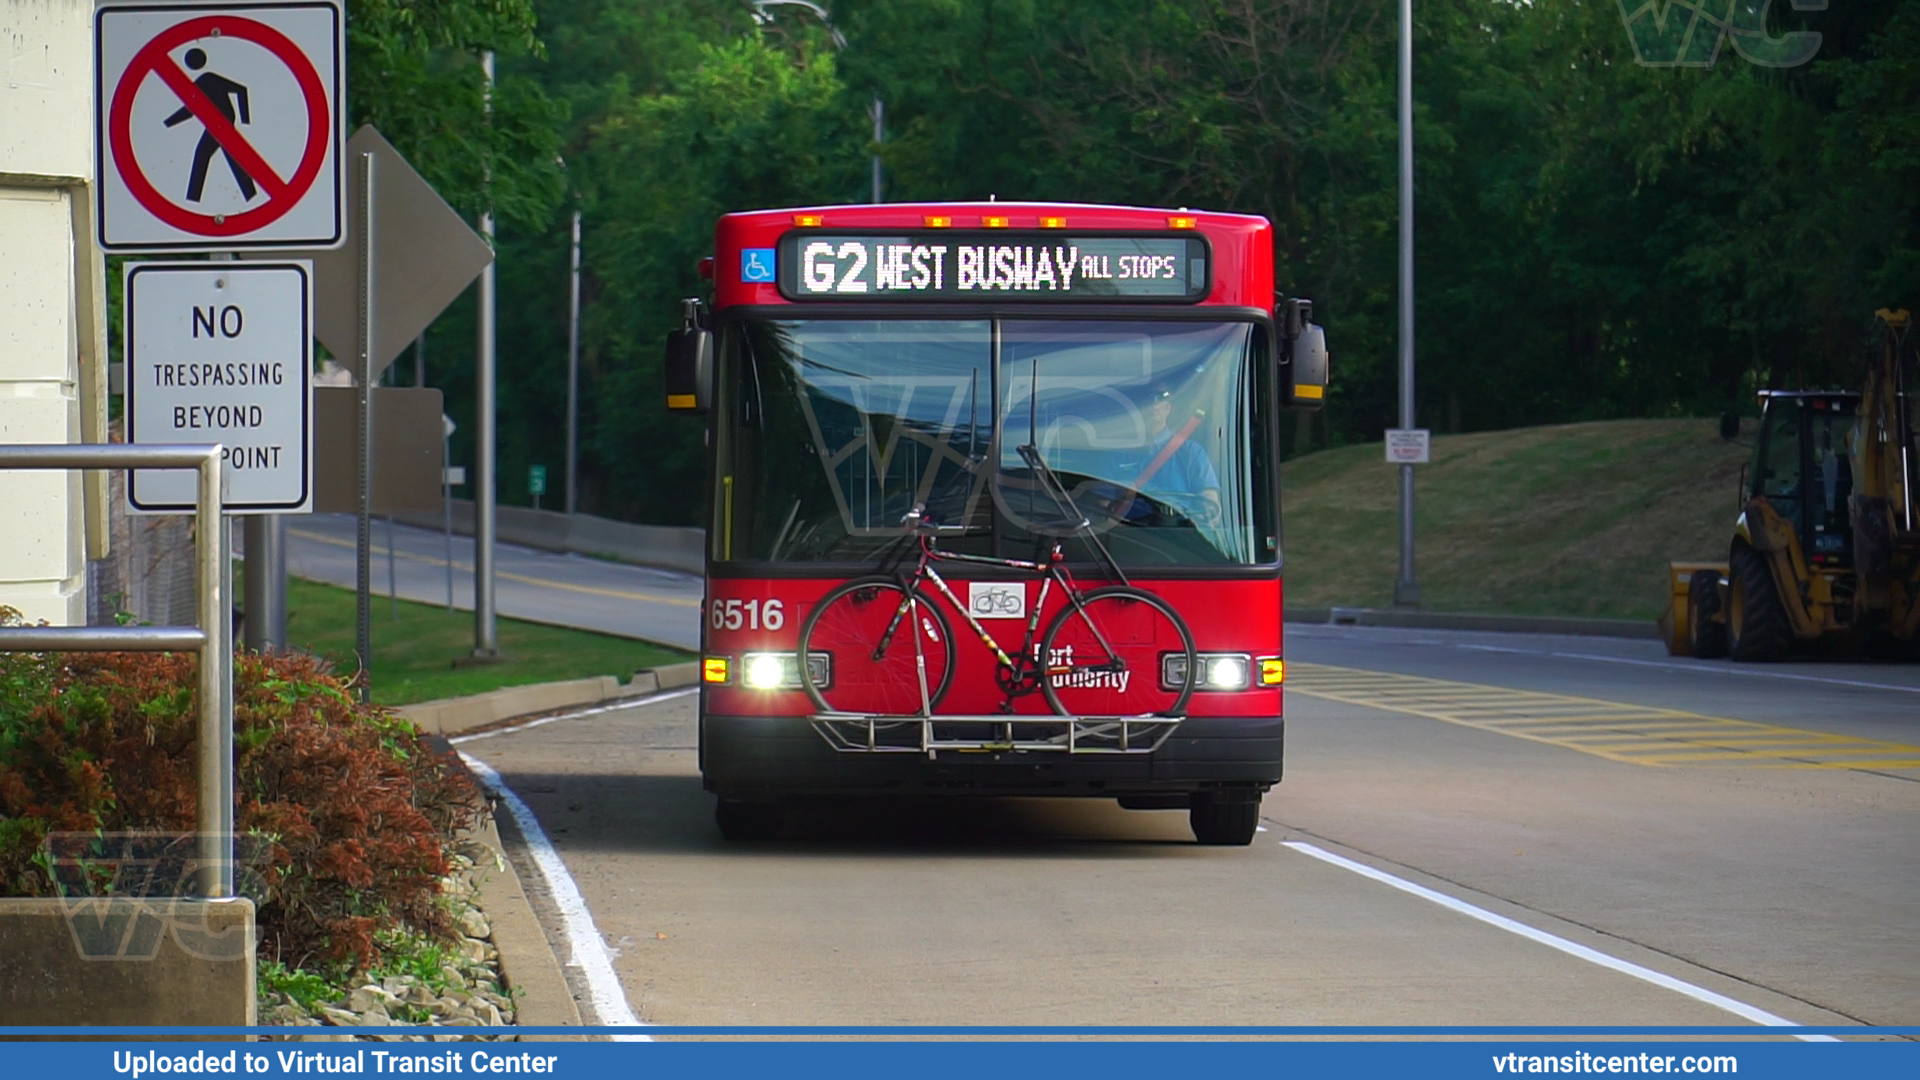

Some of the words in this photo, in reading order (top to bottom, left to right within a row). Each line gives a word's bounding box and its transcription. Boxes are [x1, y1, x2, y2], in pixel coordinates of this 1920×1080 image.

[804, 242, 868, 293] G2
[876, 245, 948, 290] WEST
[957, 246, 1078, 291] BUSWAY
[1081, 255, 1113, 279] ALL
[1118, 255, 1176, 279] STOPS
[192, 305, 243, 338] NO
[154, 362, 283, 386] TRESPASSING
[174, 405, 263, 429] BEYOND
[712, 599, 784, 630] 6516
[1036, 667, 1131, 693] uthority
